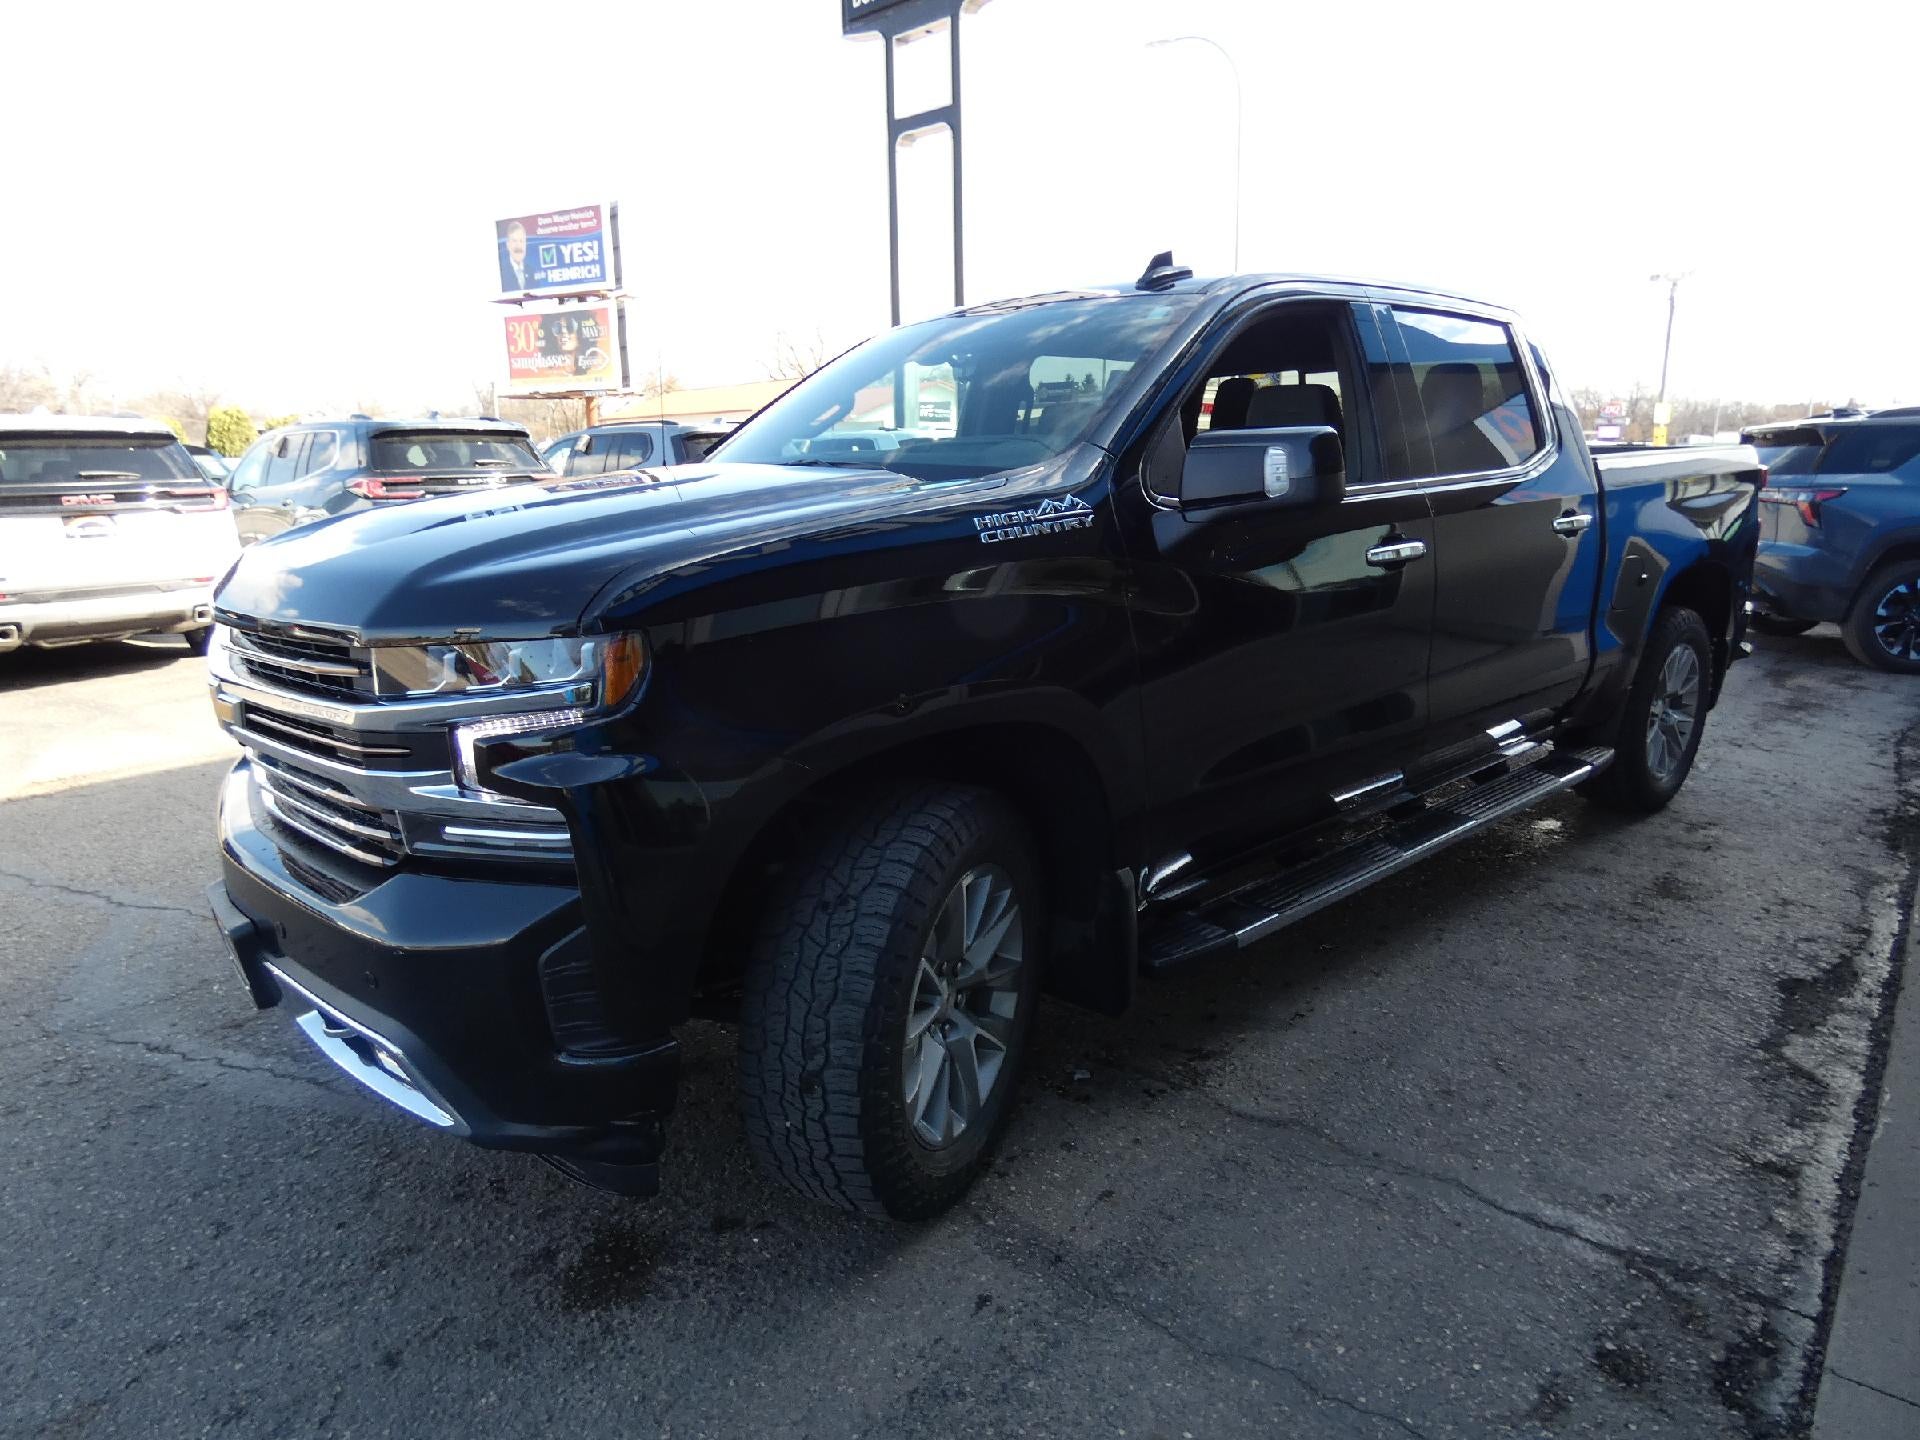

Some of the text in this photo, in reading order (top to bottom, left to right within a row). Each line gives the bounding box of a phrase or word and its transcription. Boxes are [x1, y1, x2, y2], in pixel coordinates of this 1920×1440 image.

[559, 240, 600, 265] YES!
[547, 264, 600, 282] HEINRICH
[581, 325, 600, 339] MAY
[510, 350, 573, 373] sunglasses
[974, 509, 1035, 530] HIGH
[980, 514, 1095, 544] COUNTRY
